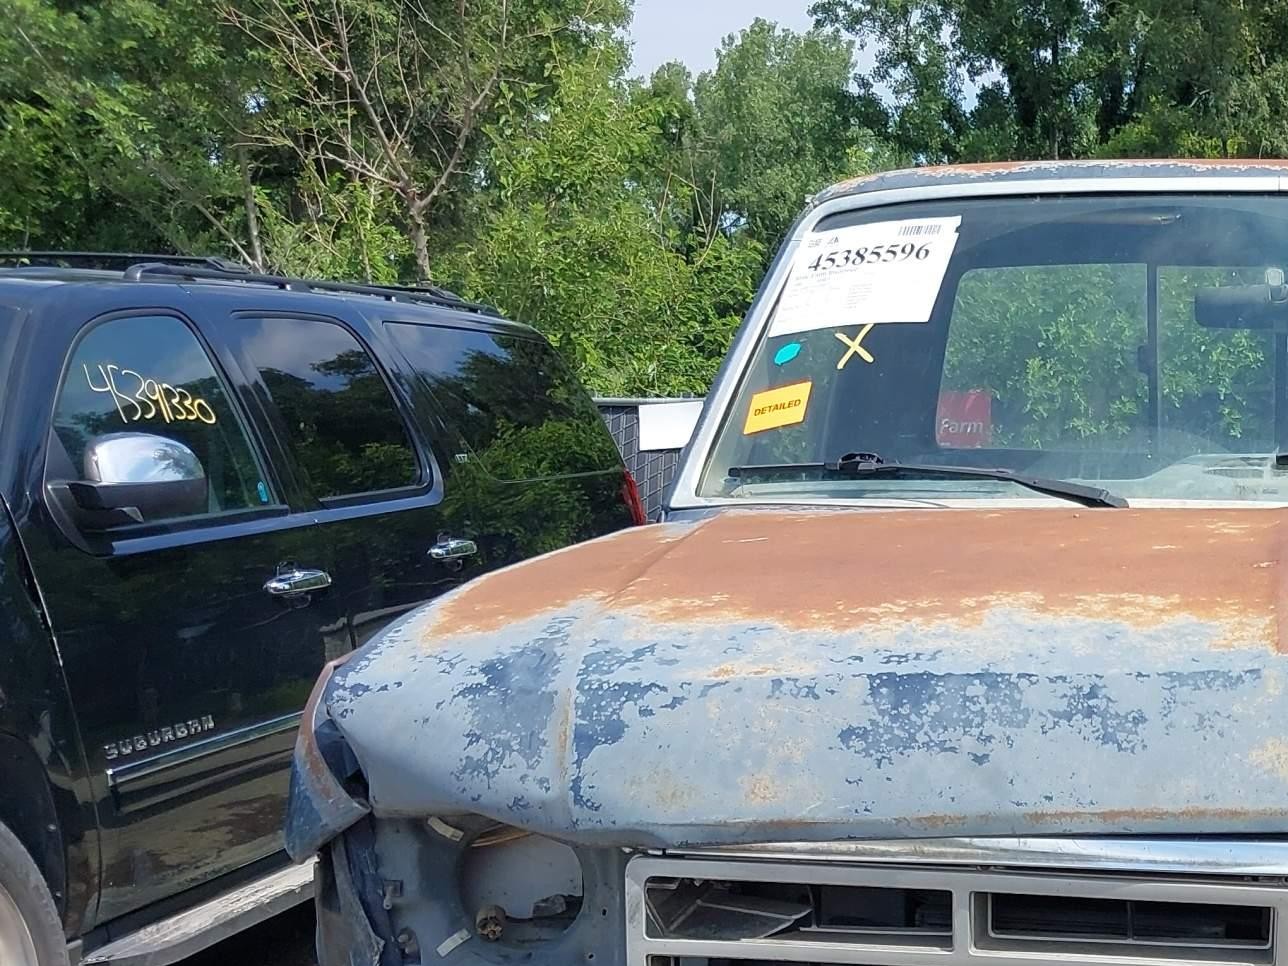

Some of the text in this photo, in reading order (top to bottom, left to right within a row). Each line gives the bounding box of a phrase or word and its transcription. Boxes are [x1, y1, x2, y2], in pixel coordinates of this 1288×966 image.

[808, 242, 932, 271] 45385596
[753, 398, 802, 417] DETAILED
[103, 714, 215, 760] SUBURBAN
